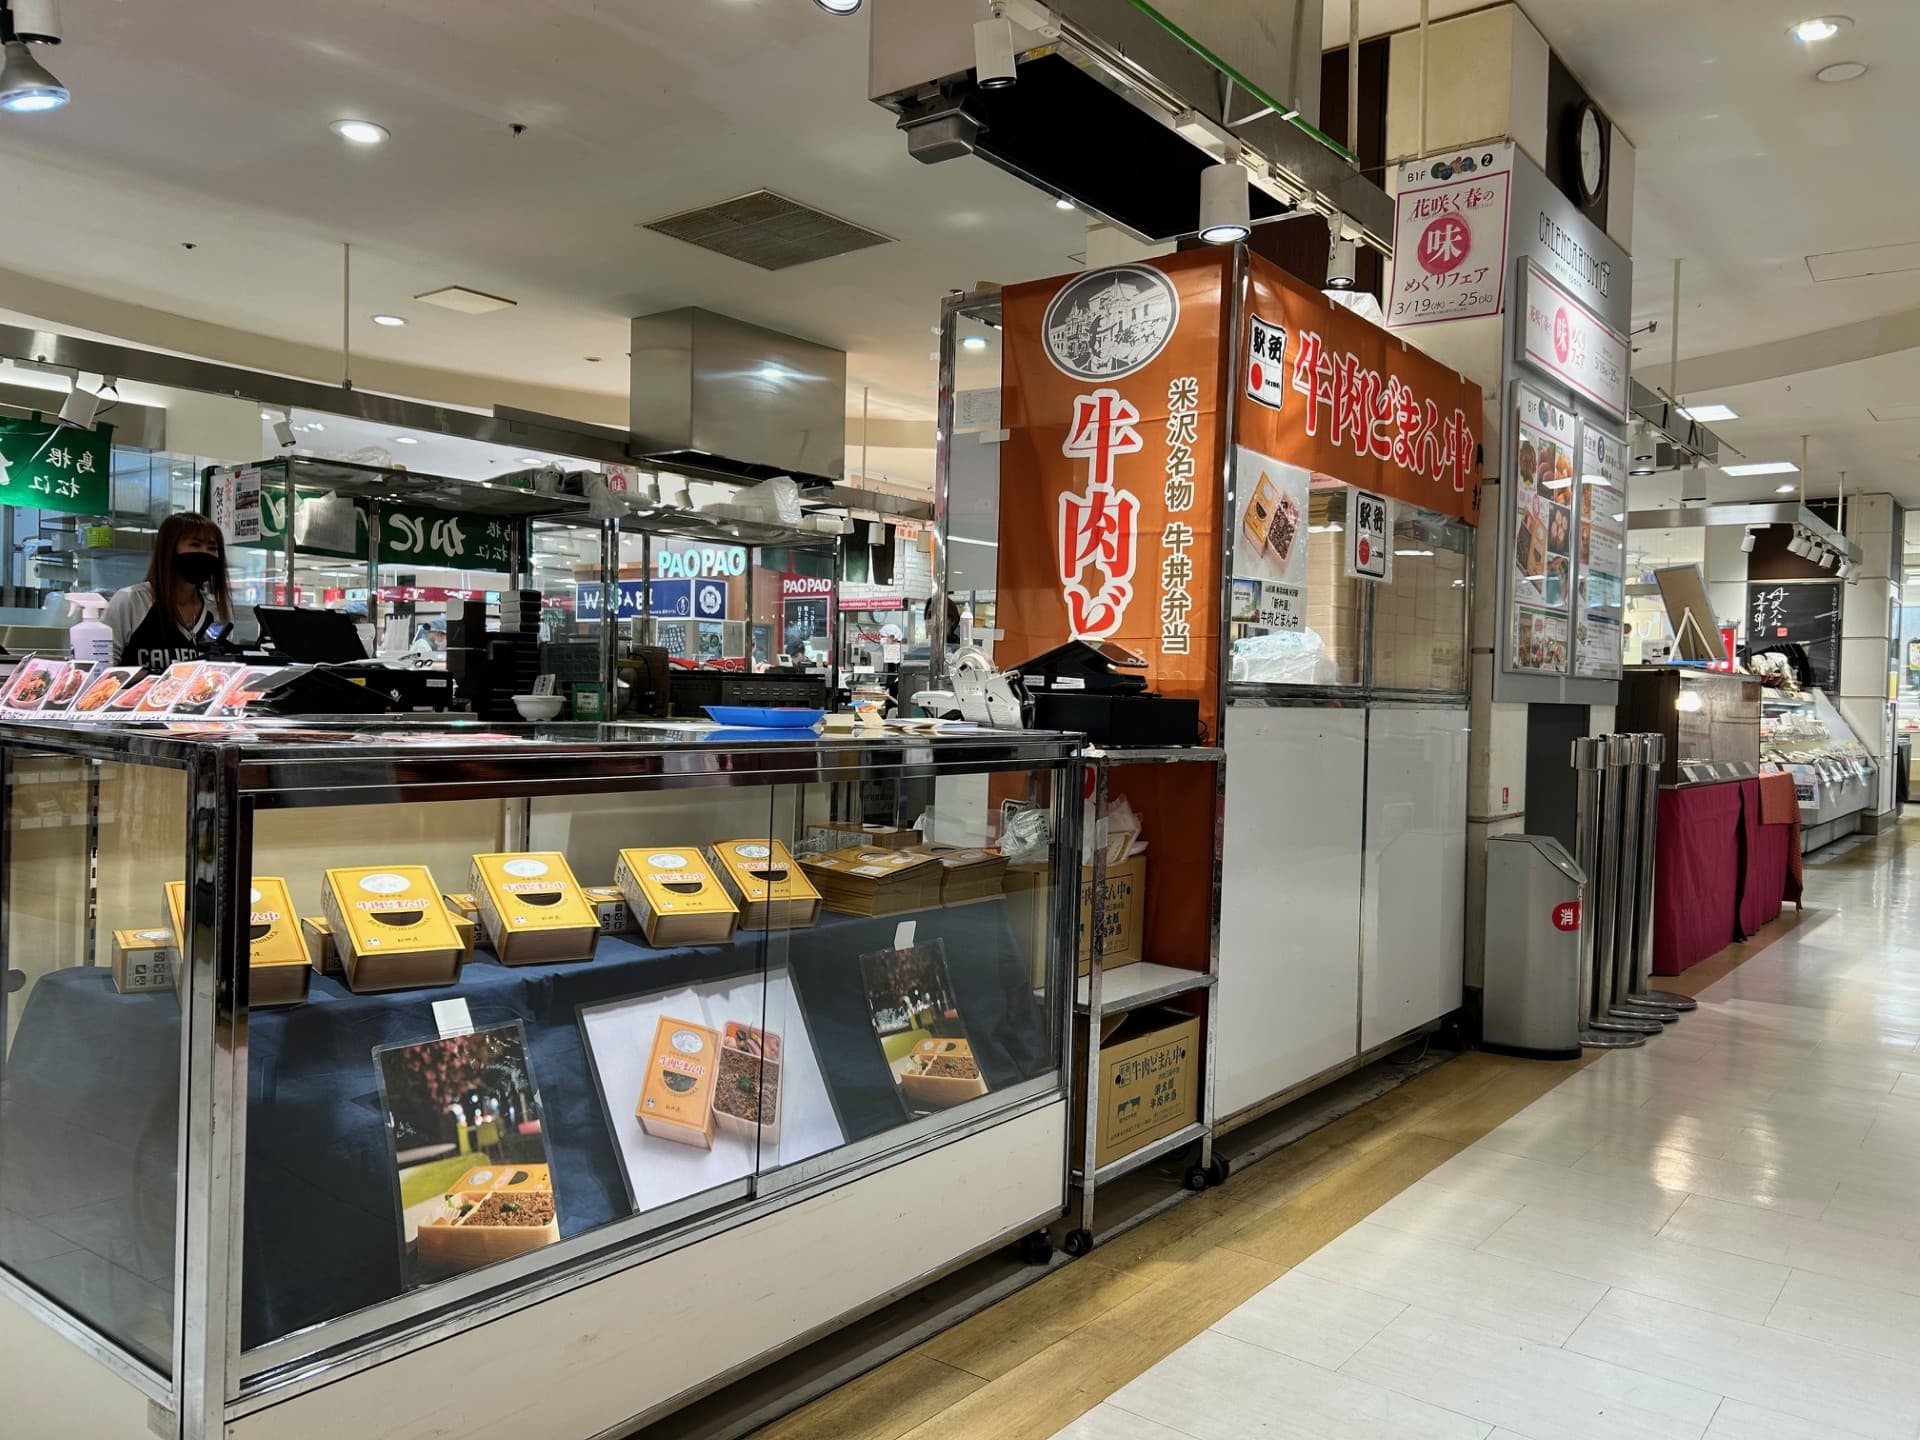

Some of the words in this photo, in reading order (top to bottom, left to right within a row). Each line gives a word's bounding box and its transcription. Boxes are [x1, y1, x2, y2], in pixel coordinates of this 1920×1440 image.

[1407, 170, 1427, 183] B1F
[1413, 187, 1495, 218] 花咲く春の
[1426, 224, 1464, 264] 味
[1404, 267, 1489, 294] めぐりフェア
[1293, 330, 1473, 492] 牛肉どまん中
[1168, 377, 1198, 512] 米沢名物
[658, 547, 747, 578] PAOPAO
[783, 577, 832, 594] PAOPAO
[1162, 522, 1194, 654] 牛丼弁当
[1260, 611, 1299, 628] 牛肉どまん中
[1131, 1044, 1181, 1080] 牛肉どまん中
